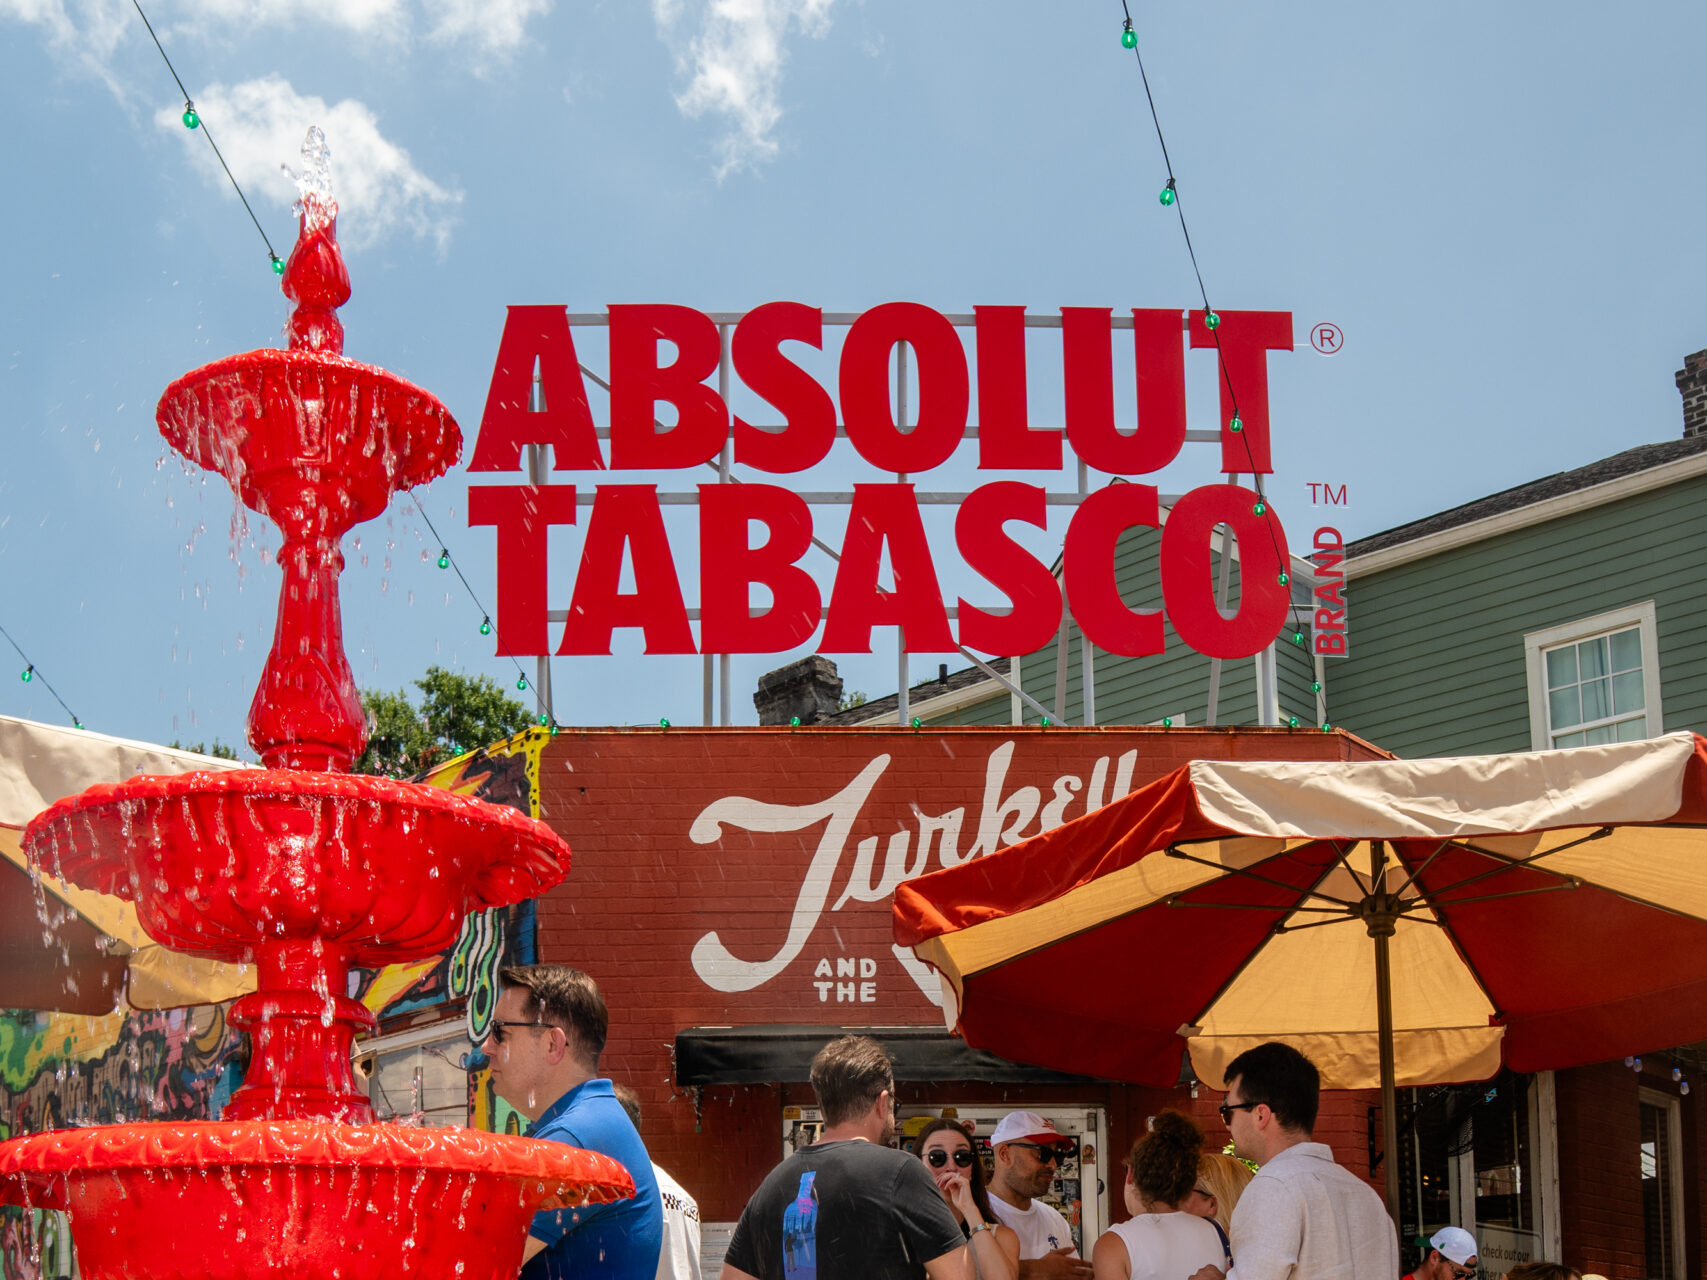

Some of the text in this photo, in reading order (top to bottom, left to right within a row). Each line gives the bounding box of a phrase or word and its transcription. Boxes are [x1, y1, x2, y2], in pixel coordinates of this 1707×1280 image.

[468, 301, 1294, 474] ABSOLUT
[468, 480, 1348, 659] TABASCO TM
[1313, 526, 1346, 655] BRAND
[814, 957, 877, 978] AND
[813, 981, 876, 1002] THE
[1482, 1244, 1530, 1263] check out our
[1477, 1266, 1497, 1280] other
